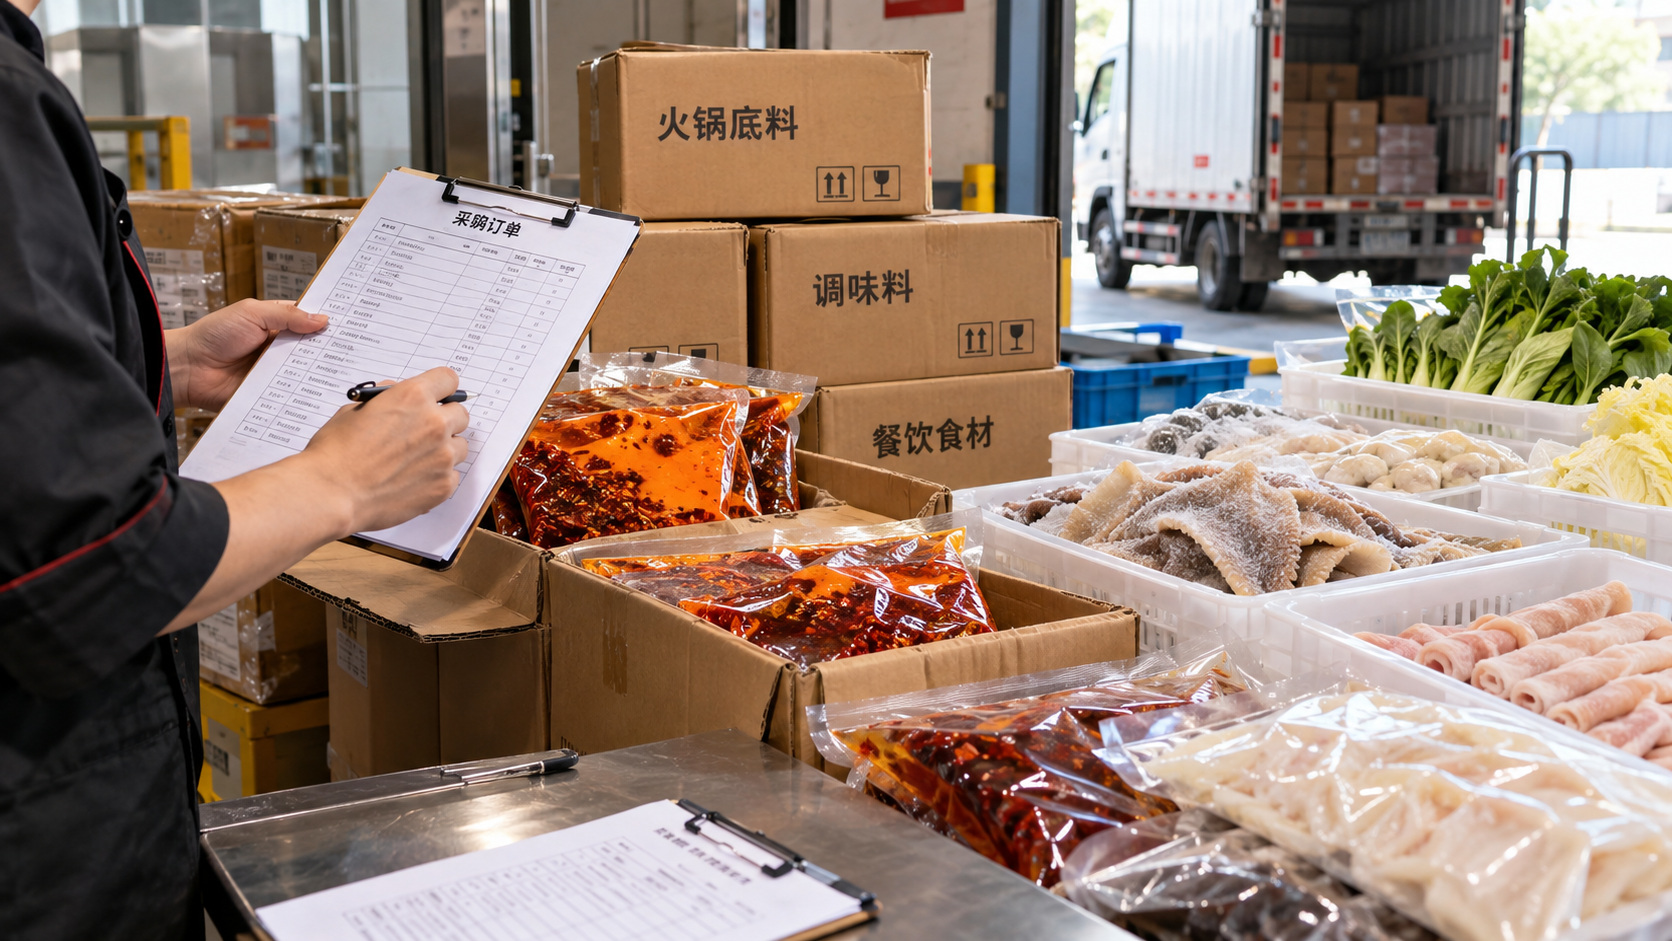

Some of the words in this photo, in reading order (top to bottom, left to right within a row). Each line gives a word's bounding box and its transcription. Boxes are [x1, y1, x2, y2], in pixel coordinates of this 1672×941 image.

[657, 105, 798, 141] 火锅底料
[812, 269, 914, 308] 调味料
[872, 416, 994, 459] 餐饮食材
